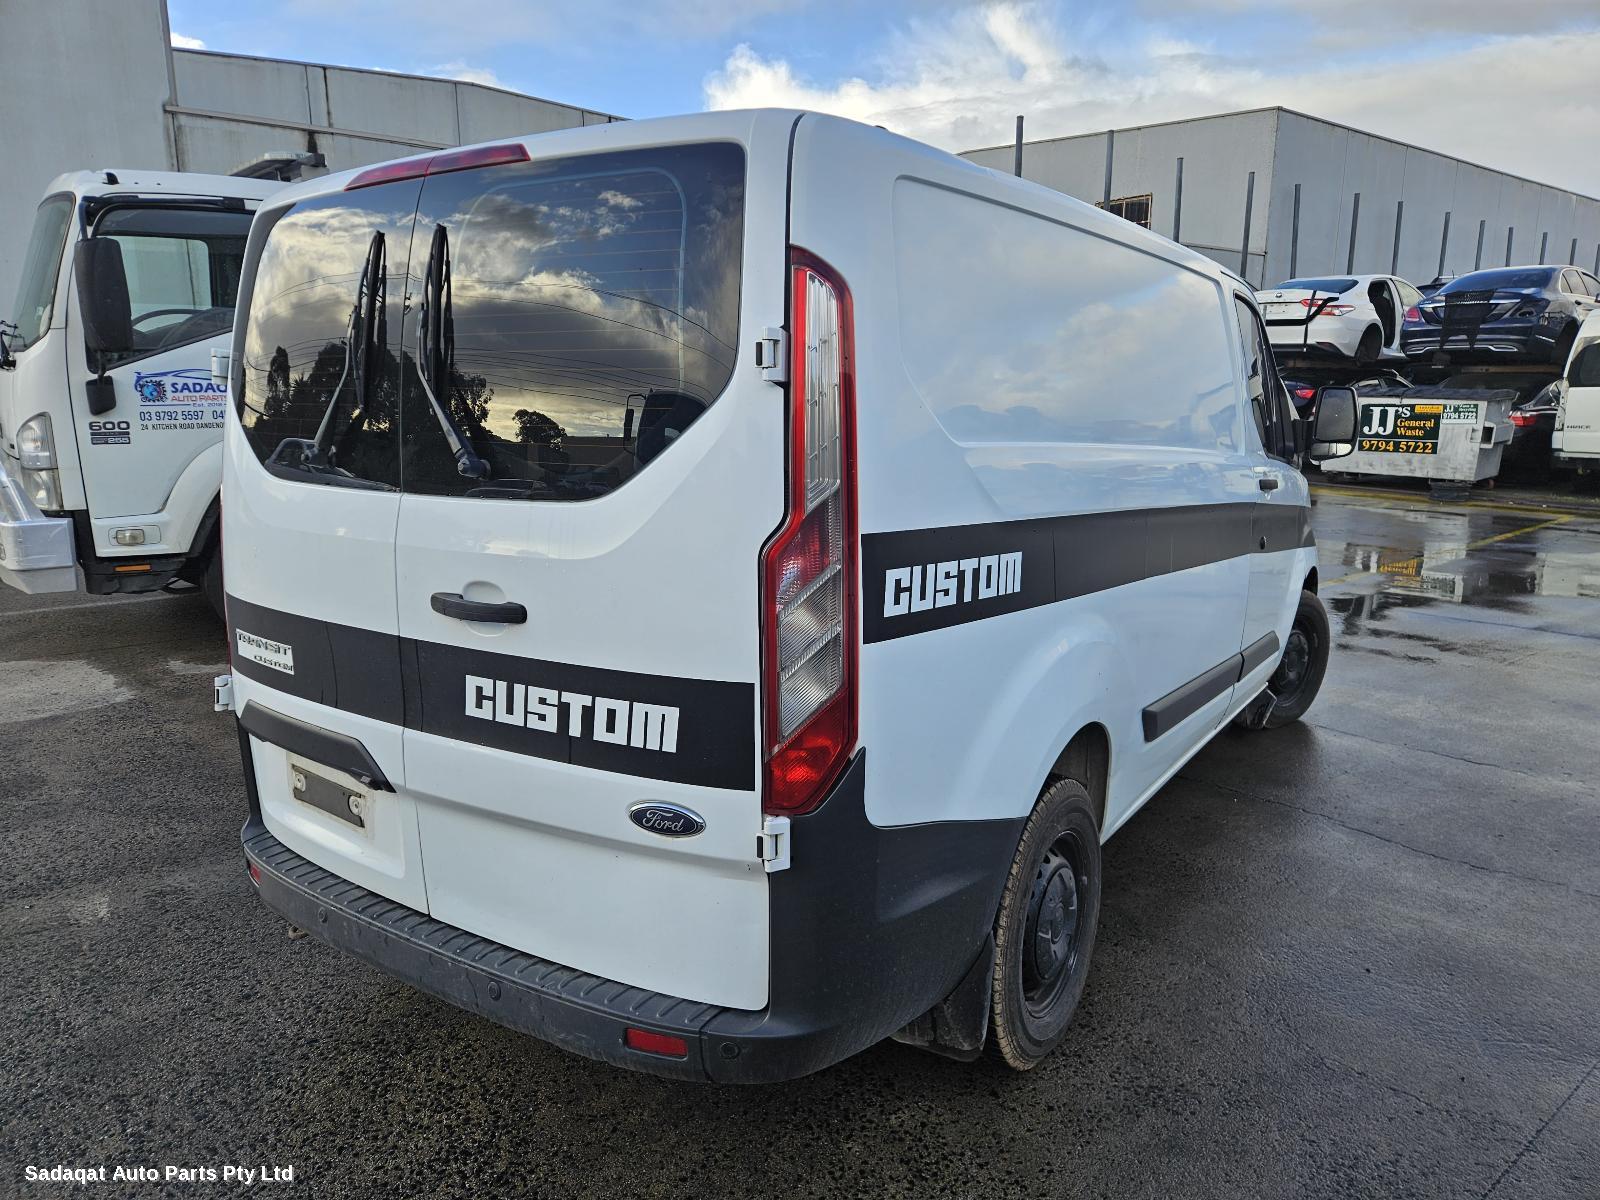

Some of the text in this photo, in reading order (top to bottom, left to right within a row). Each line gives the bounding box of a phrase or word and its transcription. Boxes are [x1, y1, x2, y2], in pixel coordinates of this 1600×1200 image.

[139, 411, 153, 421] 03
[154, 411, 179, 421] 9792
[181, 410, 204, 420] 5597
[89, 421, 130, 431] 600
[1397, 419, 1435, 428] General
[1397, 427, 1424, 436] Waste
[1362, 440, 1433, 453] 9794 5722
[884, 551, 1023, 618] CUSTOM
[465, 674, 680, 753] CUSTOM
[642, 809, 684, 832] Ford
